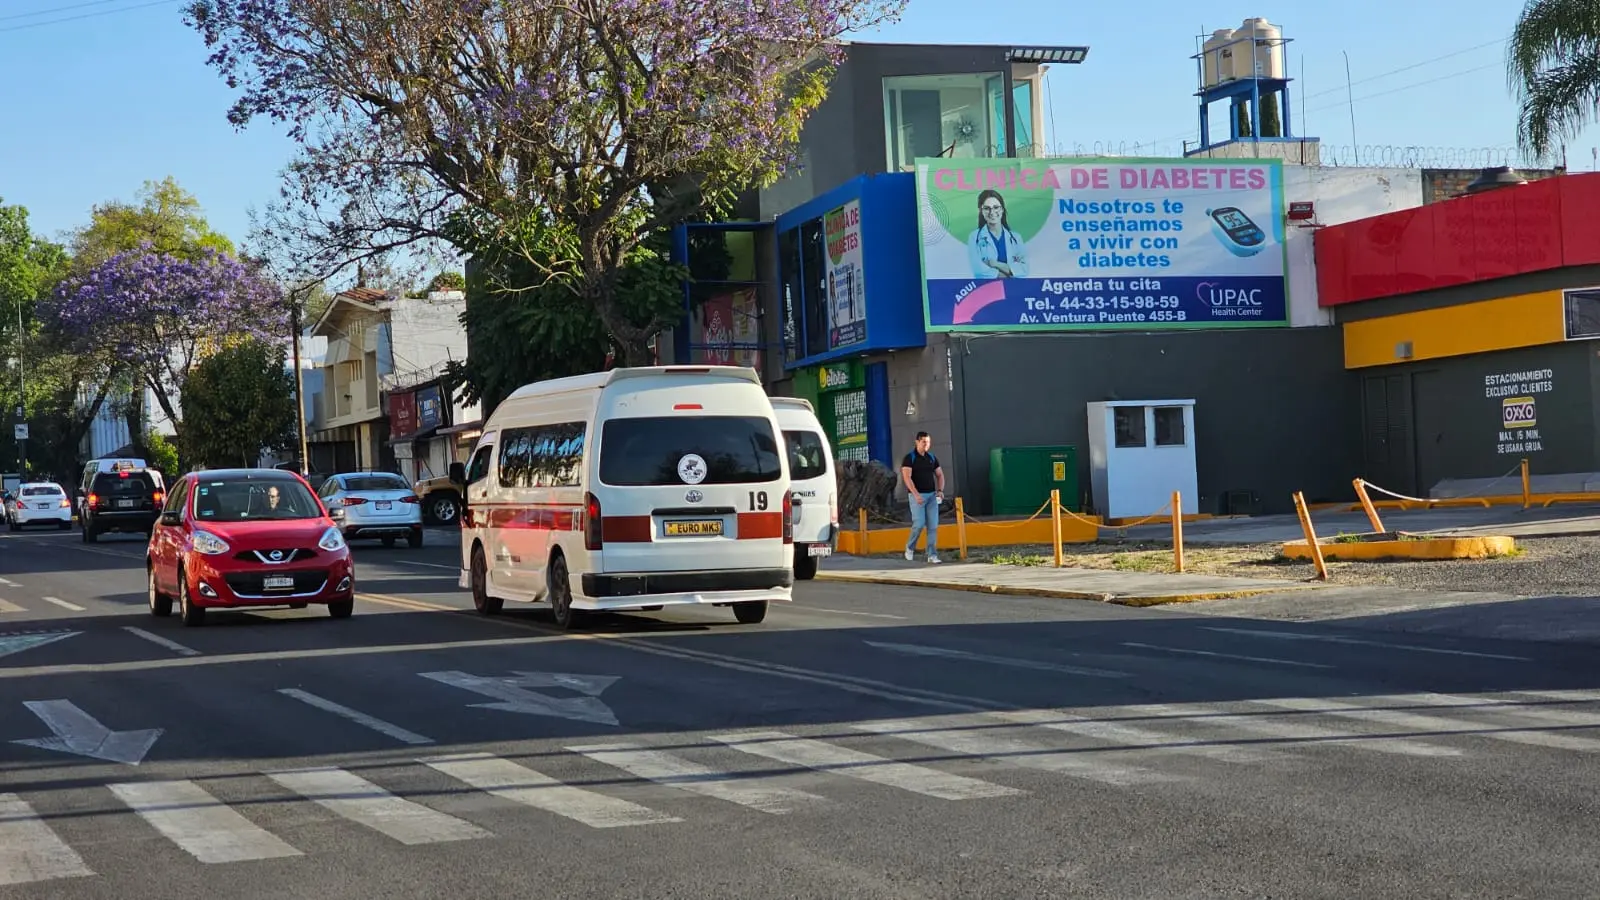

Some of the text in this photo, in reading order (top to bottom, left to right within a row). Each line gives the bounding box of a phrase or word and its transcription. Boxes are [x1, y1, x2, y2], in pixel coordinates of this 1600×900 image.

[934, 168, 1266, 190] CLINICA DE DIABETES
[1059, 199, 1184, 214] Nosotros te
[850, 207, 859, 226] DE
[1061, 216, 1183, 232] enseñamos
[1068, 234, 1179, 250] a vivir con
[1078, 252, 1171, 268] diabetes
[955, 281, 977, 302] AQUI
[1041, 278, 1161, 294] Agenda tu cita
[1024, 295, 1180, 310] Tel. 44-33-15-98-59
[1210, 289, 1263, 306] UPAC
[1019, 310, 1187, 323] Av. Ventura Puente 455-B
[1211, 307, 1263, 317] Health Center
[1485, 369, 1553, 385] ESTACIONAMIENTO
[1485, 380, 1553, 398] EXCLUSIVO CLIENTES
[1505, 404, 1534, 421] OXXO
[1497, 443, 1505, 454] SE
[749, 491, 768, 511] 19
[677, 521, 720, 533] EURO MK3
